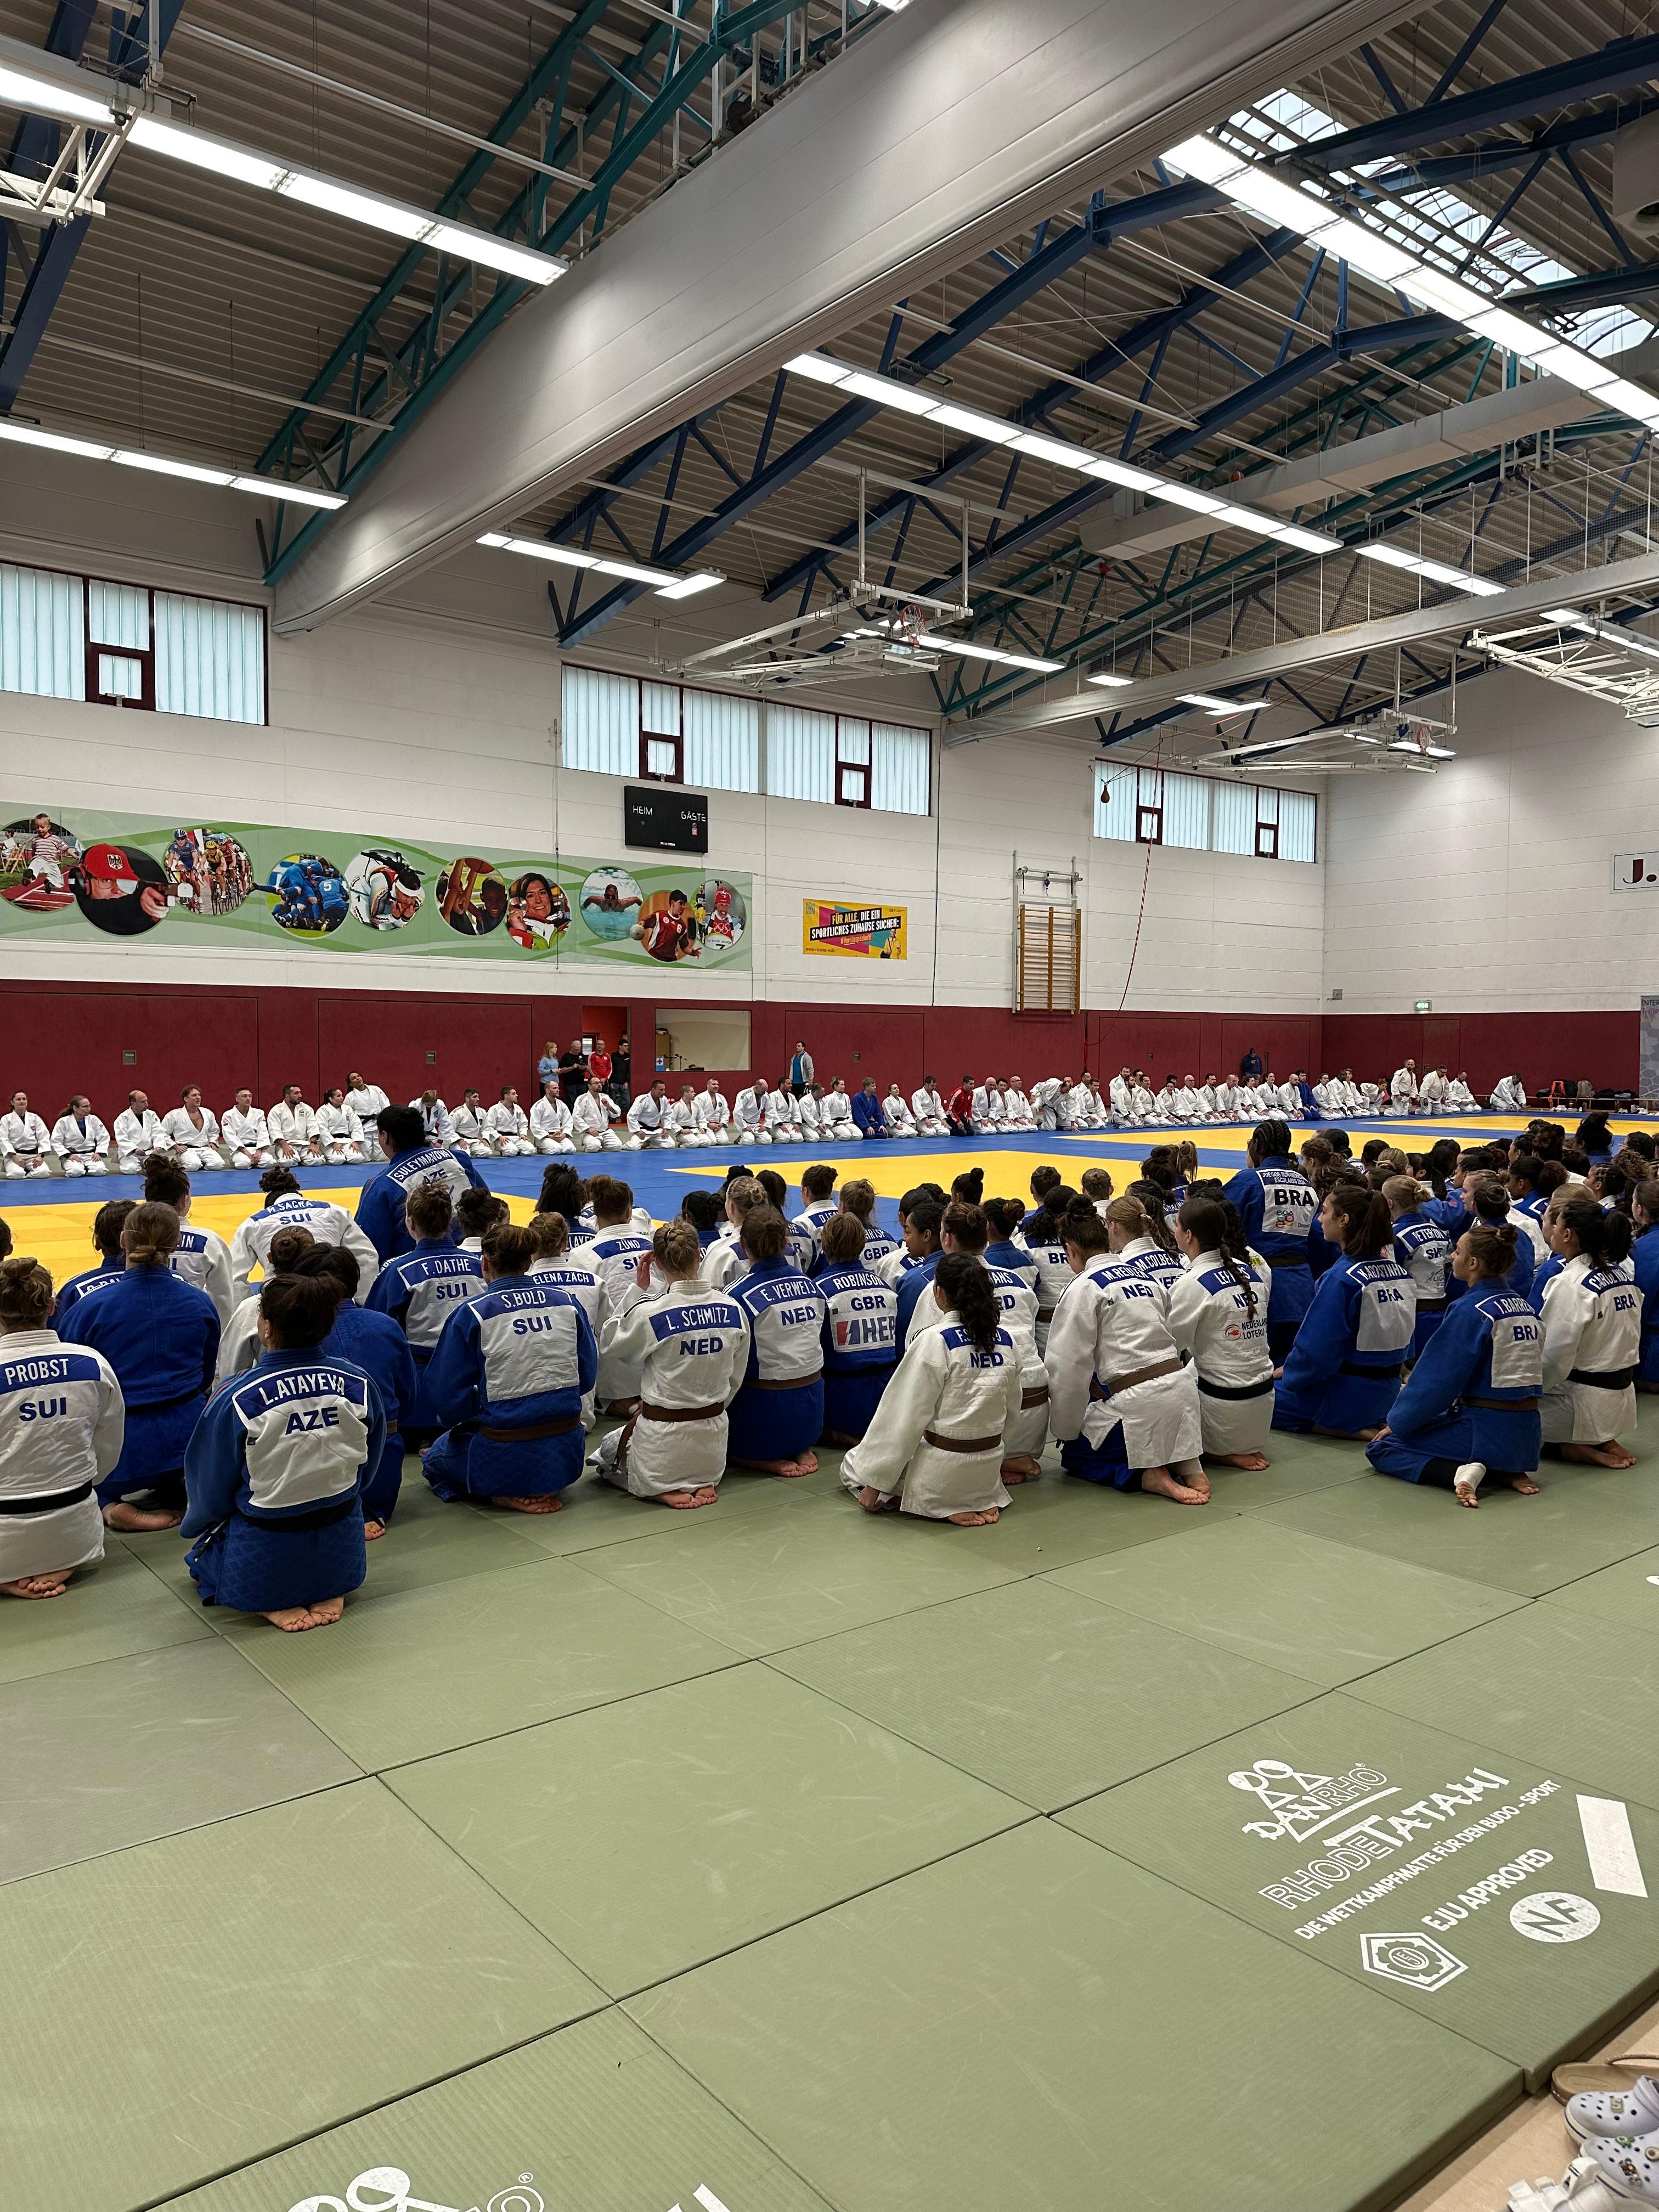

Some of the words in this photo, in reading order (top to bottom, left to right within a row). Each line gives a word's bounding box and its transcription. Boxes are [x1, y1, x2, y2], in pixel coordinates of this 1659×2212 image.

[633, 805, 653, 816] HEIM
[681, 811, 707, 822] GÄSTE
[323, 879, 332, 891] 5
[832, 913, 843, 924] FÜR
[845, 912, 859, 924] ALLE,
[861, 911, 870, 921] DIE
[871, 910, 880, 919] EIN
[676, 924, 682, 934] 6
[811, 924, 849, 939] SPORTLICHES
[850, 921, 874, 934] ZUHAUSE
[876, 918, 899, 929] SUCHEN:
[393, 1149, 451, 1180] SULEYMANOVA
[422, 1168, 448, 1185] AZE
[1274, 1189, 1315, 1206] BRA
[267, 1200, 313, 1214] M.SAGRA
[279, 1213, 312, 1224] SUI
[616, 1239, 640, 1251] ZÜND
[864, 1246, 890, 1261] GBR
[1048, 1252, 1069, 1264] BR
[533, 1272, 563, 1285] ELENA
[565, 1271, 590, 1283] ZÄCH
[832, 1273, 885, 1290] ROBINSON
[436, 1283, 468, 1300] SUI
[1121, 1284, 1154, 1299] NED
[1377, 1288, 1404, 1304] BRA
[851, 1295, 887, 1311] GBR
[1613, 1294, 1637, 1312] BRA
[665, 1314, 680, 1330] L.
[681, 1307, 730, 1327] SCHMITZ
[781, 1306, 816, 1326] NED
[512, 1315, 552, 1335] SUI
[679, 1337, 724, 1356] NED
[970, 1352, 1005, 1368] NED
[4, 1358, 69, 1385] PROBST
[19, 1397, 67, 1421] SUI
[285, 1406, 340, 1435] AZE
[1294, 1921, 1328, 1940] DIE
[1319, 1850, 1442, 1931] WETTKAMPFMATTE
[1433, 1836, 1466, 1861] FÜR
[1457, 1823, 1485, 1849] DEN
[1479, 1804, 1521, 1835] BUDO
[1519, 1779, 1562, 1805] SPORT
[1421, 1897, 1469, 1932] EJU
[1462, 1848, 1554, 1909] APPROVED
